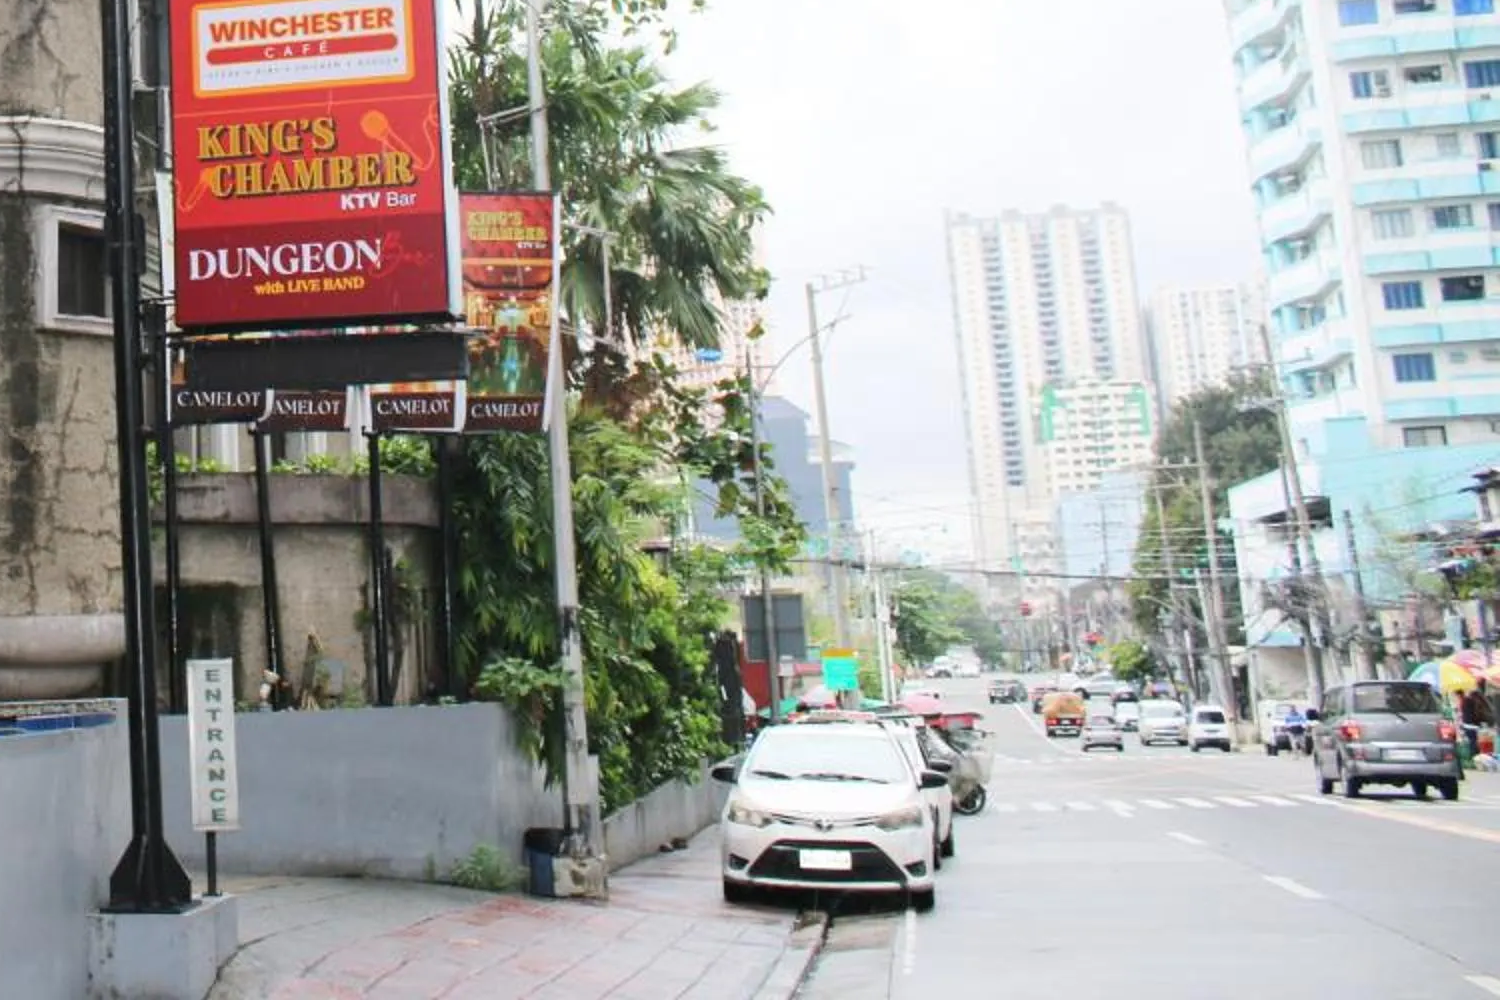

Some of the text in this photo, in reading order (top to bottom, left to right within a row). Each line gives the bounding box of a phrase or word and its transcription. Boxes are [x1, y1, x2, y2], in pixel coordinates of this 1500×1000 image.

[209, 7, 395, 43] WINCHESTER
[263, 40, 329, 60] CAFÉ
[196, 116, 336, 160] KING'S
[211, 151, 417, 198] CHAMBER
[340, 190, 417, 210] KTV Bar
[189, 238, 382, 282] DUNGEON
[255, 275, 366, 296] with LIVE BAND
[177, 390, 262, 408] CAMELOT
[271, 399, 341, 416] AMELOT
[377, 398, 451, 416] CAMELOT
[471, 402, 541, 419] CAMELOT
[204, 668, 228, 824] ENTRANCE
